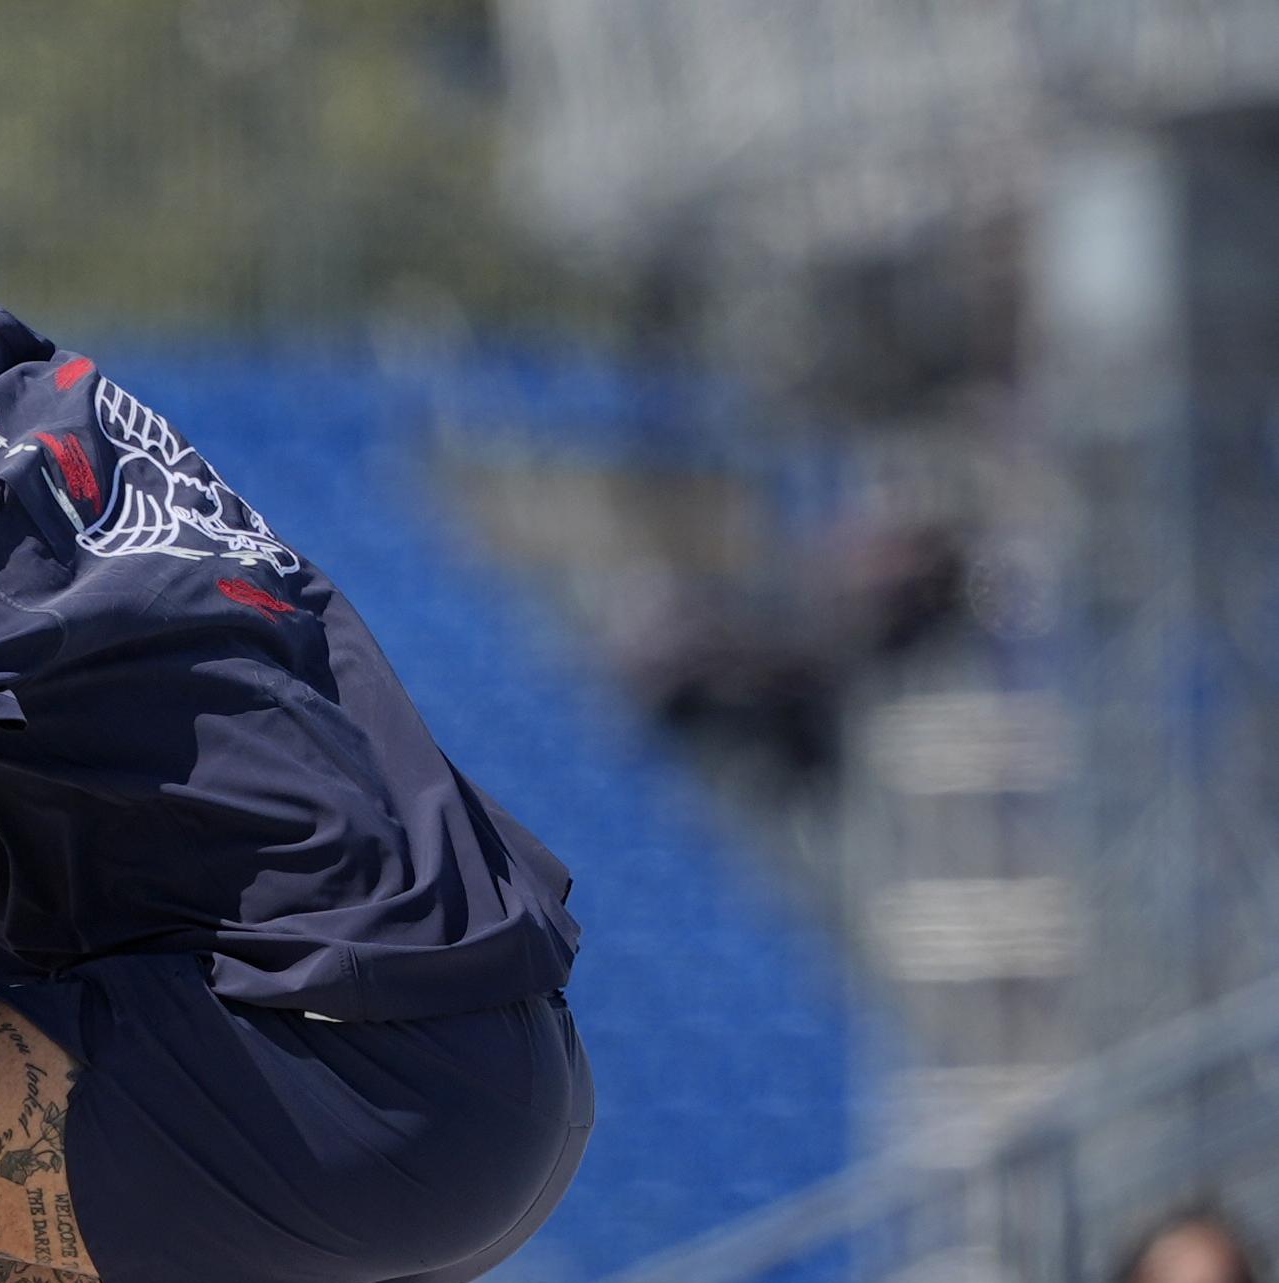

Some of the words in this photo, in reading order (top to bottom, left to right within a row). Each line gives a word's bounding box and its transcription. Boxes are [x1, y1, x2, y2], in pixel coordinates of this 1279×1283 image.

[18, 1062, 48, 1138] looked
[27, 1188, 47, 1216] THE
[55, 1192, 79, 1258] WELCOME
